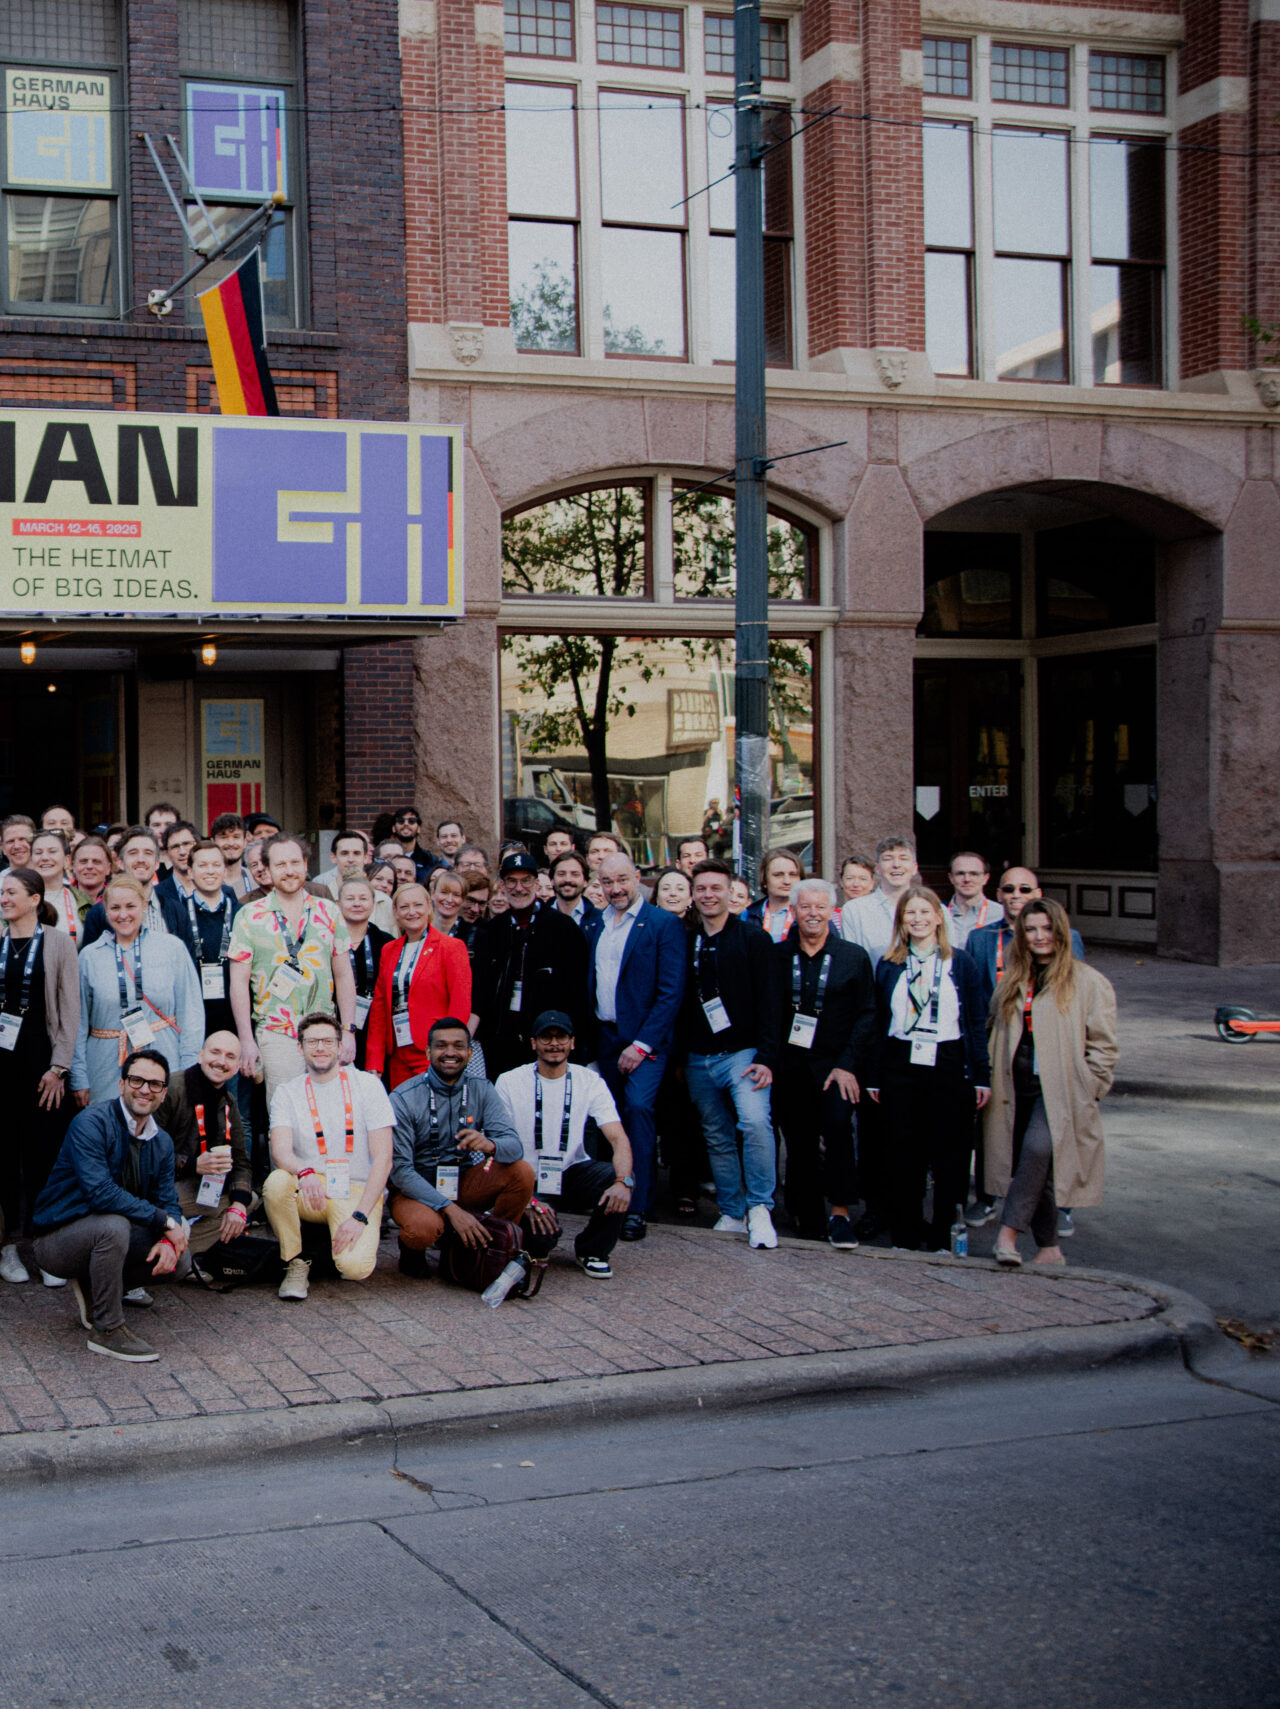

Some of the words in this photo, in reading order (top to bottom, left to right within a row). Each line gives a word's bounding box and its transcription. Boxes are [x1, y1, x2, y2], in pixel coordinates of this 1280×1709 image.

[11, 76, 105, 97] GERMAN
[11, 92, 71, 111] HAUS
[19, 522, 64, 534] MARCH
[107, 523, 138, 536] 2026
[12, 547, 63, 568] THE
[71, 548, 172, 570] HEIMAT
[12, 577, 45, 597] OF
[55, 578, 103, 598] BIG
[113, 578, 199, 600] IDEAS.
[206, 760, 262, 770] GERMAN
[206, 770, 242, 779] HAUS
[968, 784, 1009, 797] ENTER
